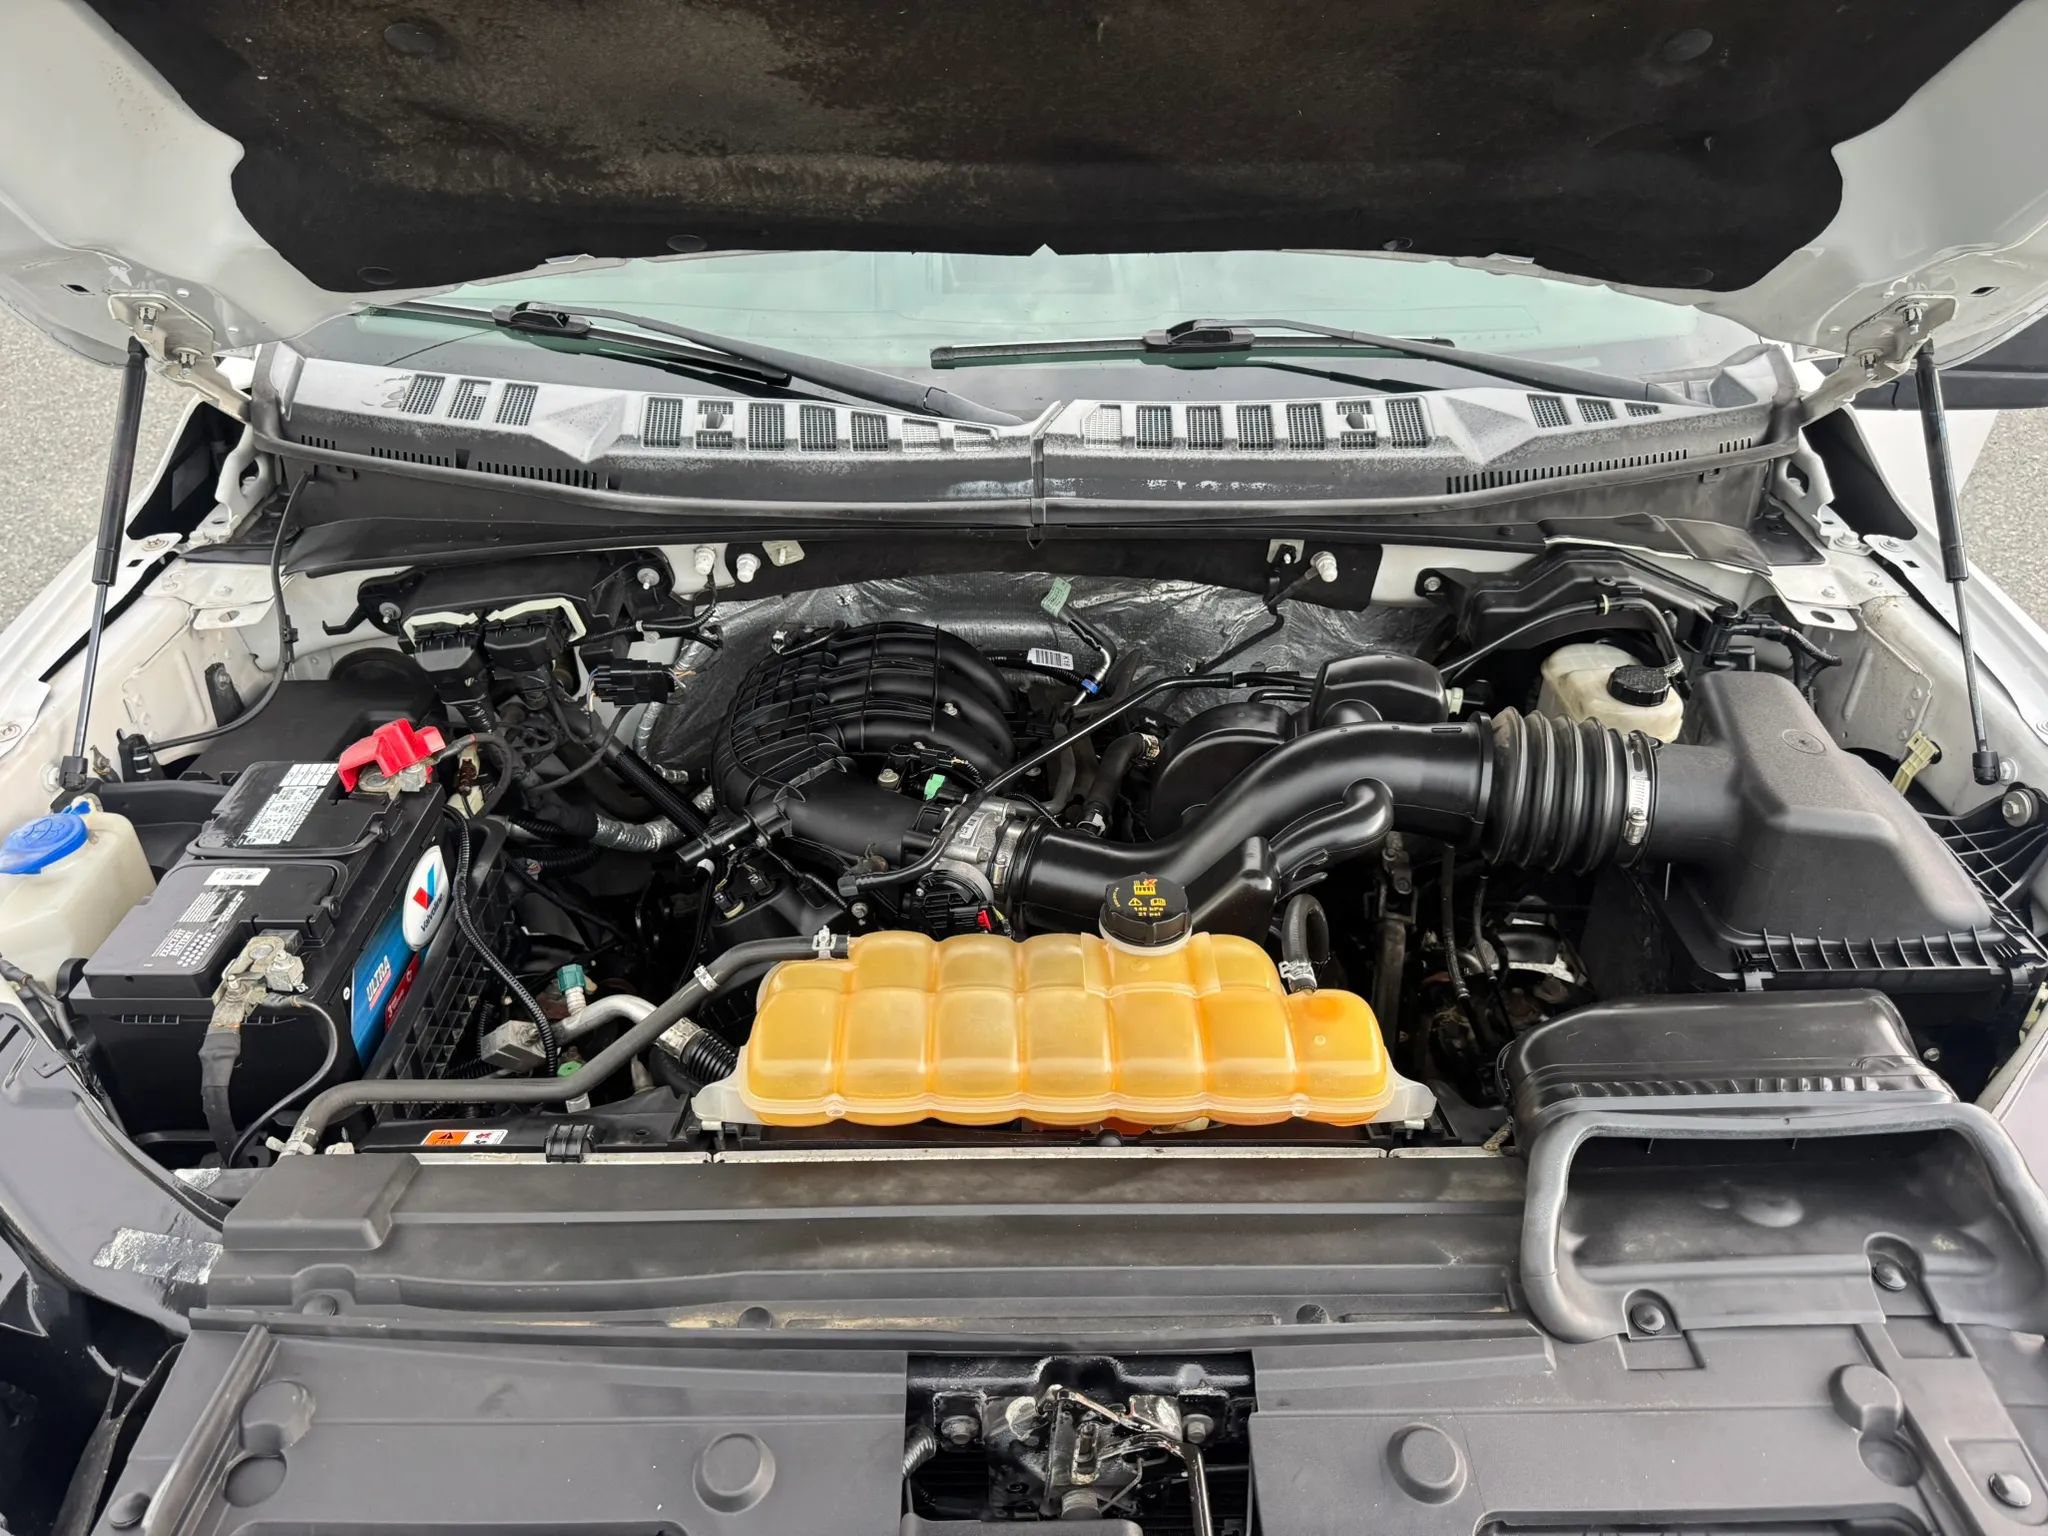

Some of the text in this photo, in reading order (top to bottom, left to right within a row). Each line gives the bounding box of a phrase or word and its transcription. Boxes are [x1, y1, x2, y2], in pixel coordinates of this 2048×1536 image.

[420, 892, 444, 933] Valvoline
[168, 929, 195, 957] BATTERY
[366, 954, 392, 1003] ULTRA
